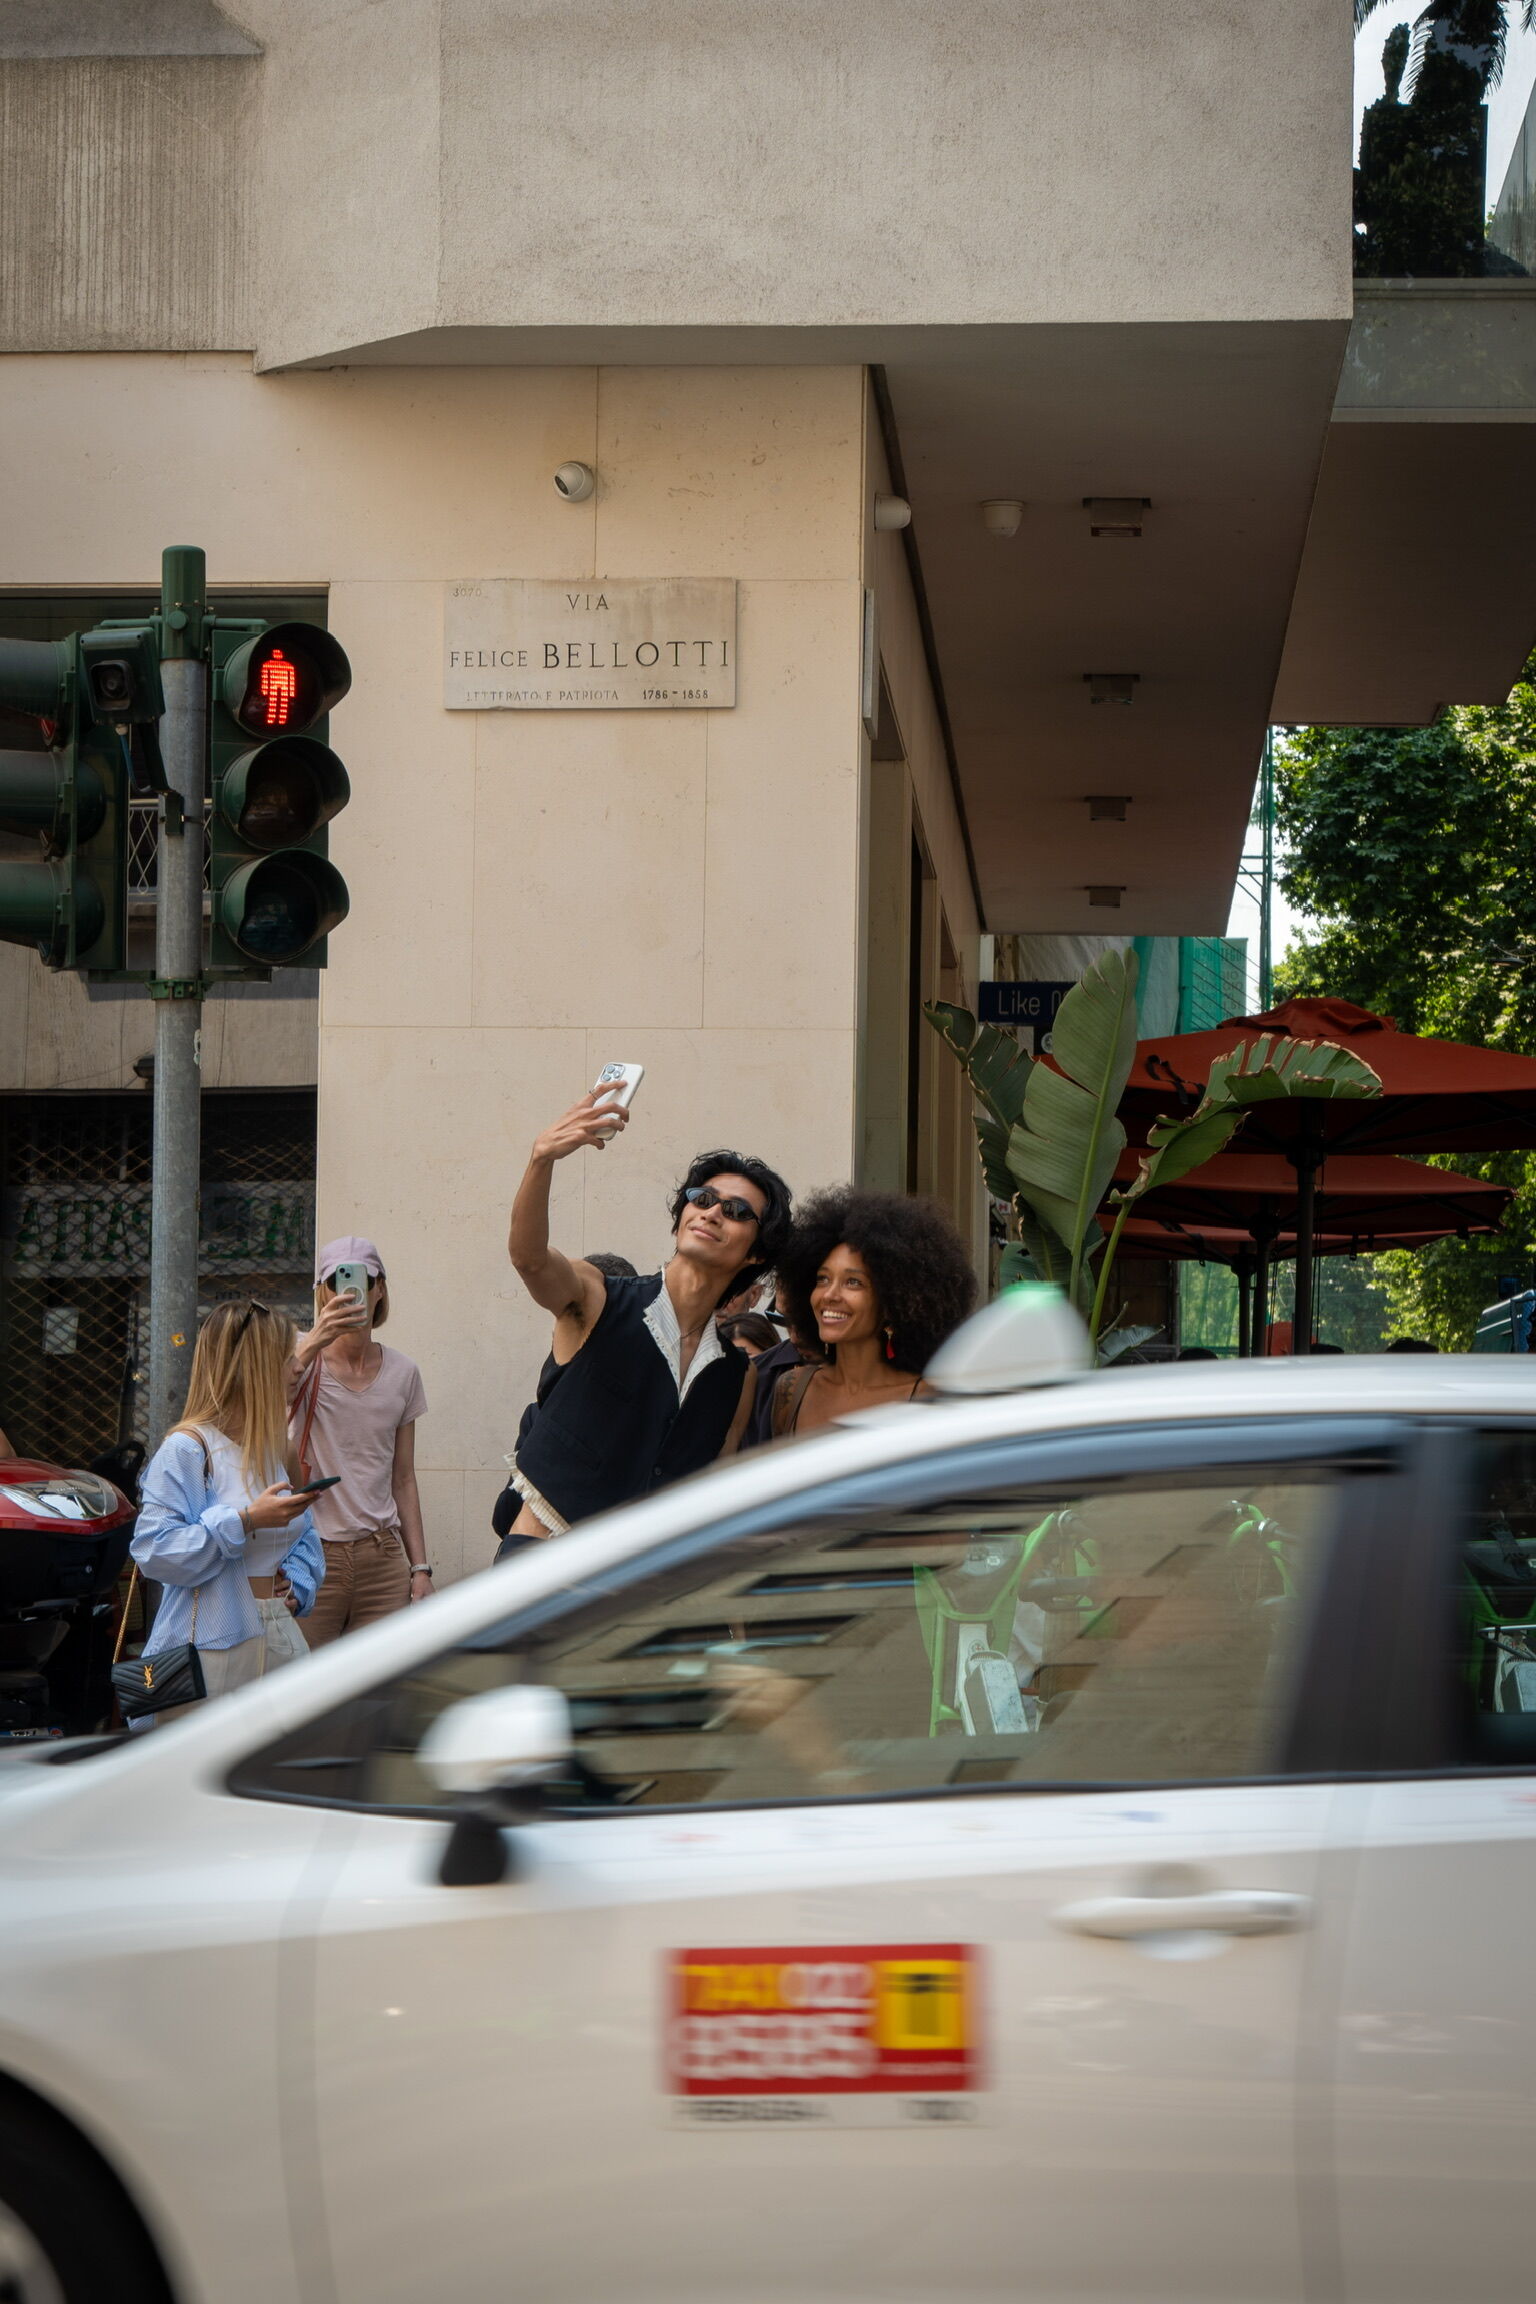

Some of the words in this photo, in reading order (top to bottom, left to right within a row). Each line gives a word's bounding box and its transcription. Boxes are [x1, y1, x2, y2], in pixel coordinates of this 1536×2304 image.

[567, 594, 609, 611] VIA
[450, 650, 528, 668] FELICE
[543, 641, 729, 668] BELLOTTI
[559, 690, 619, 701] PATRIOTA
[997, 990, 1041, 1016] Like
